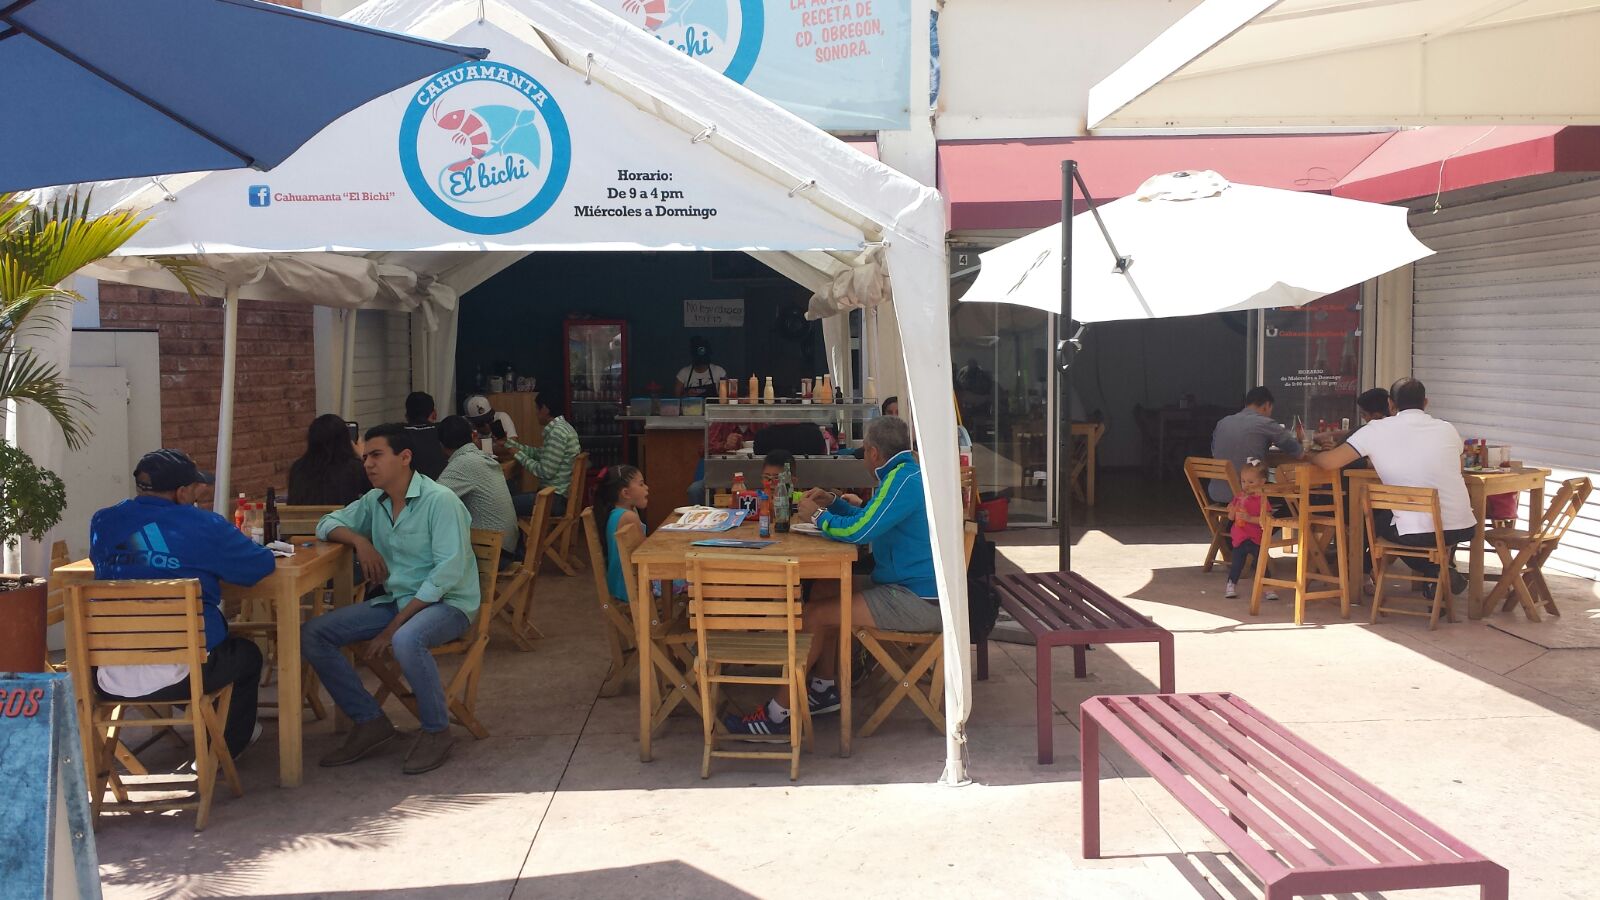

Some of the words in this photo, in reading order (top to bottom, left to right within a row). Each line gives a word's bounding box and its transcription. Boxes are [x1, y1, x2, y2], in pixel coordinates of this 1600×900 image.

[802, 4, 852, 27] RECETA
[855, 1, 872, 18] DE
[796, 31, 817, 48] CD.
[815, 39, 871, 63] SONORA.
[417, 66, 549, 107] CAHUAMANTA
[450, 166, 476, 196] El
[478, 155, 529, 188] bichi
[617, 169, 673, 181] Horario:
[274, 193, 342, 202] Cahuamanta
[607, 187, 626, 199] De
[629, 187, 637, 199] 9
[640, 190, 648, 199] a
[650, 187, 658, 199] 4
[661, 190, 684, 201] pm
[574, 205, 642, 217] Miércoles
[645, 208, 653, 217] a
[655, 205, 717, 219] Domingo
[959, 255, 967, 265] 4
